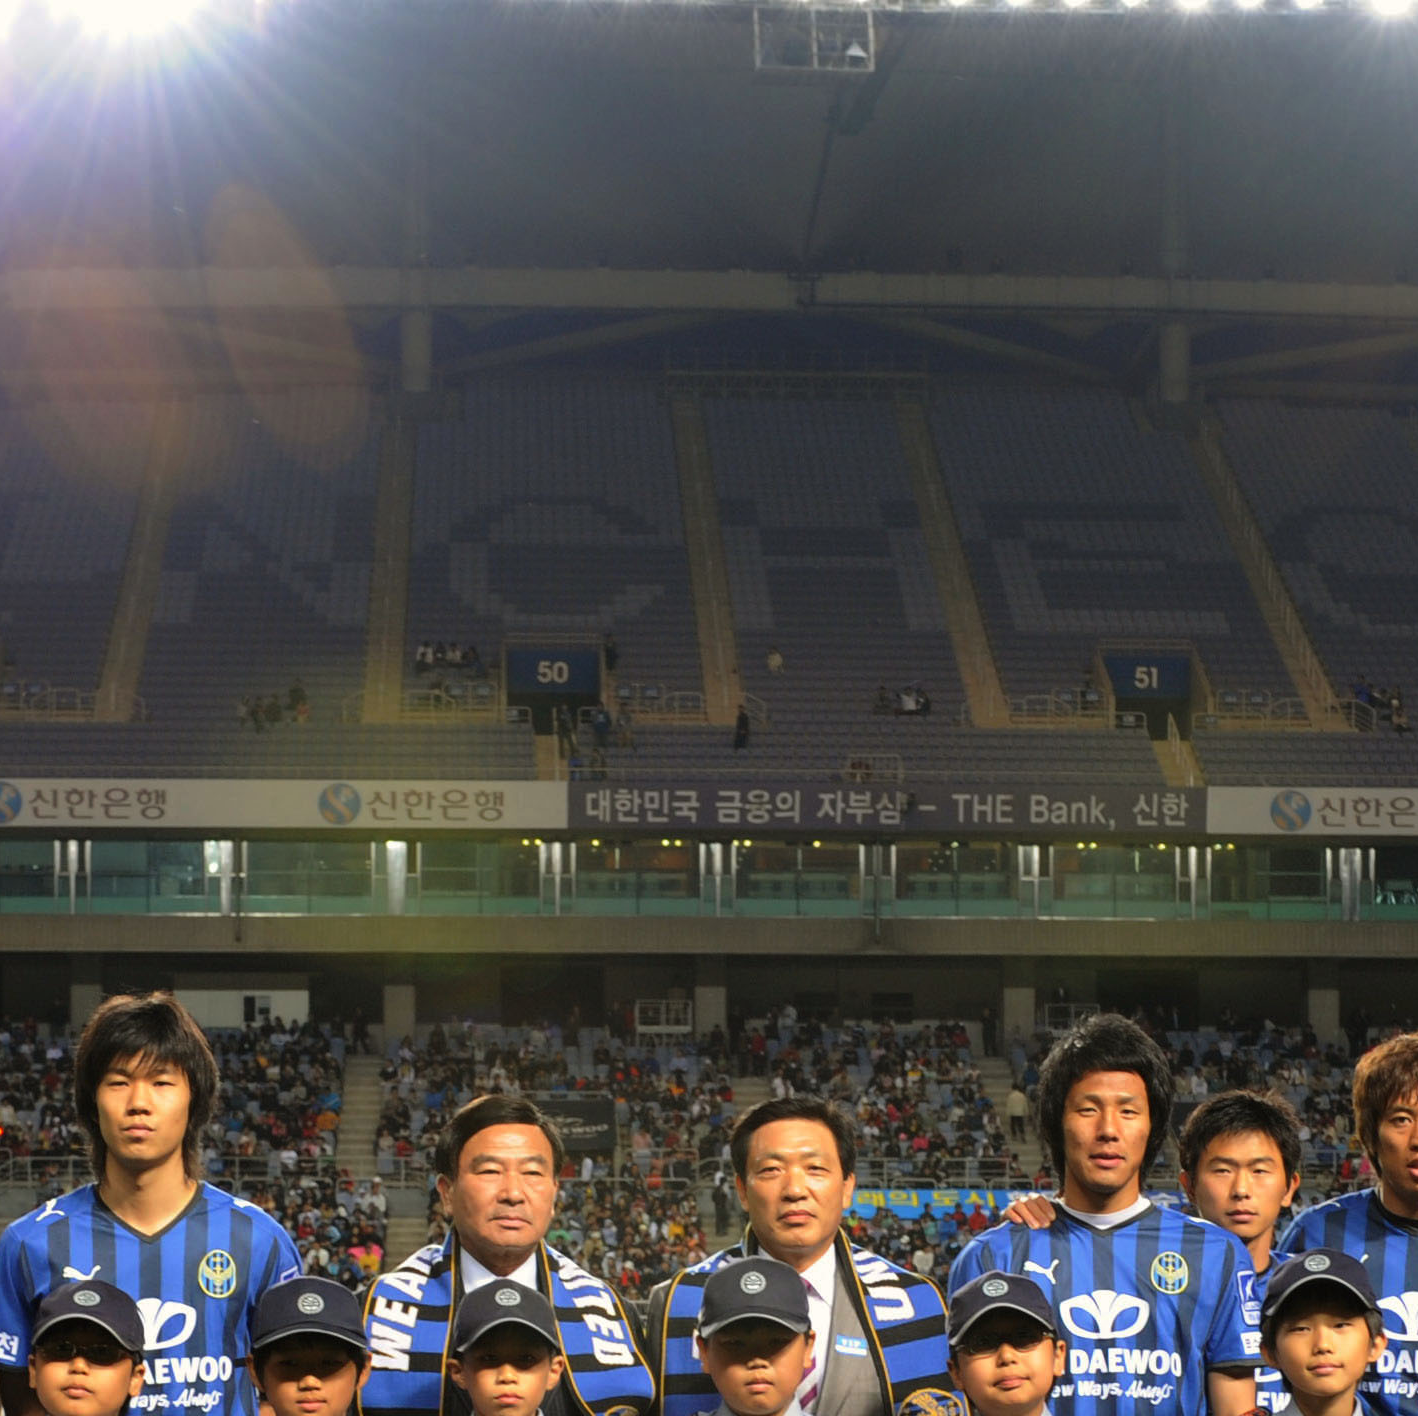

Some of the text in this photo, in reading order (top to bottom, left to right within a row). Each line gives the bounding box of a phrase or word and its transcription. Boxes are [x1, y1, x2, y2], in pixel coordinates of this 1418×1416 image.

[537, 660, 569, 684] 50
[1134, 666, 1160, 689] 51
[29, 787, 167, 821] 신한은행
[366, 789, 505, 822] 신한은행
[586, 788, 700, 824] 대한민국
[715, 789, 801, 825] 금융의
[817, 790, 903, 826] 자부심
[952, 794, 1014, 824] THE
[1030, 795, 1116, 830] Bank,
[1133, 794, 1188, 827] 신한
[369, 1295, 419, 1371] WE
[142, 1355, 232, 1385] AEWOO
[1070, 1348, 1182, 1377] DAEWOO
[1051, 1379, 1173, 1405] ew Ways, Always
